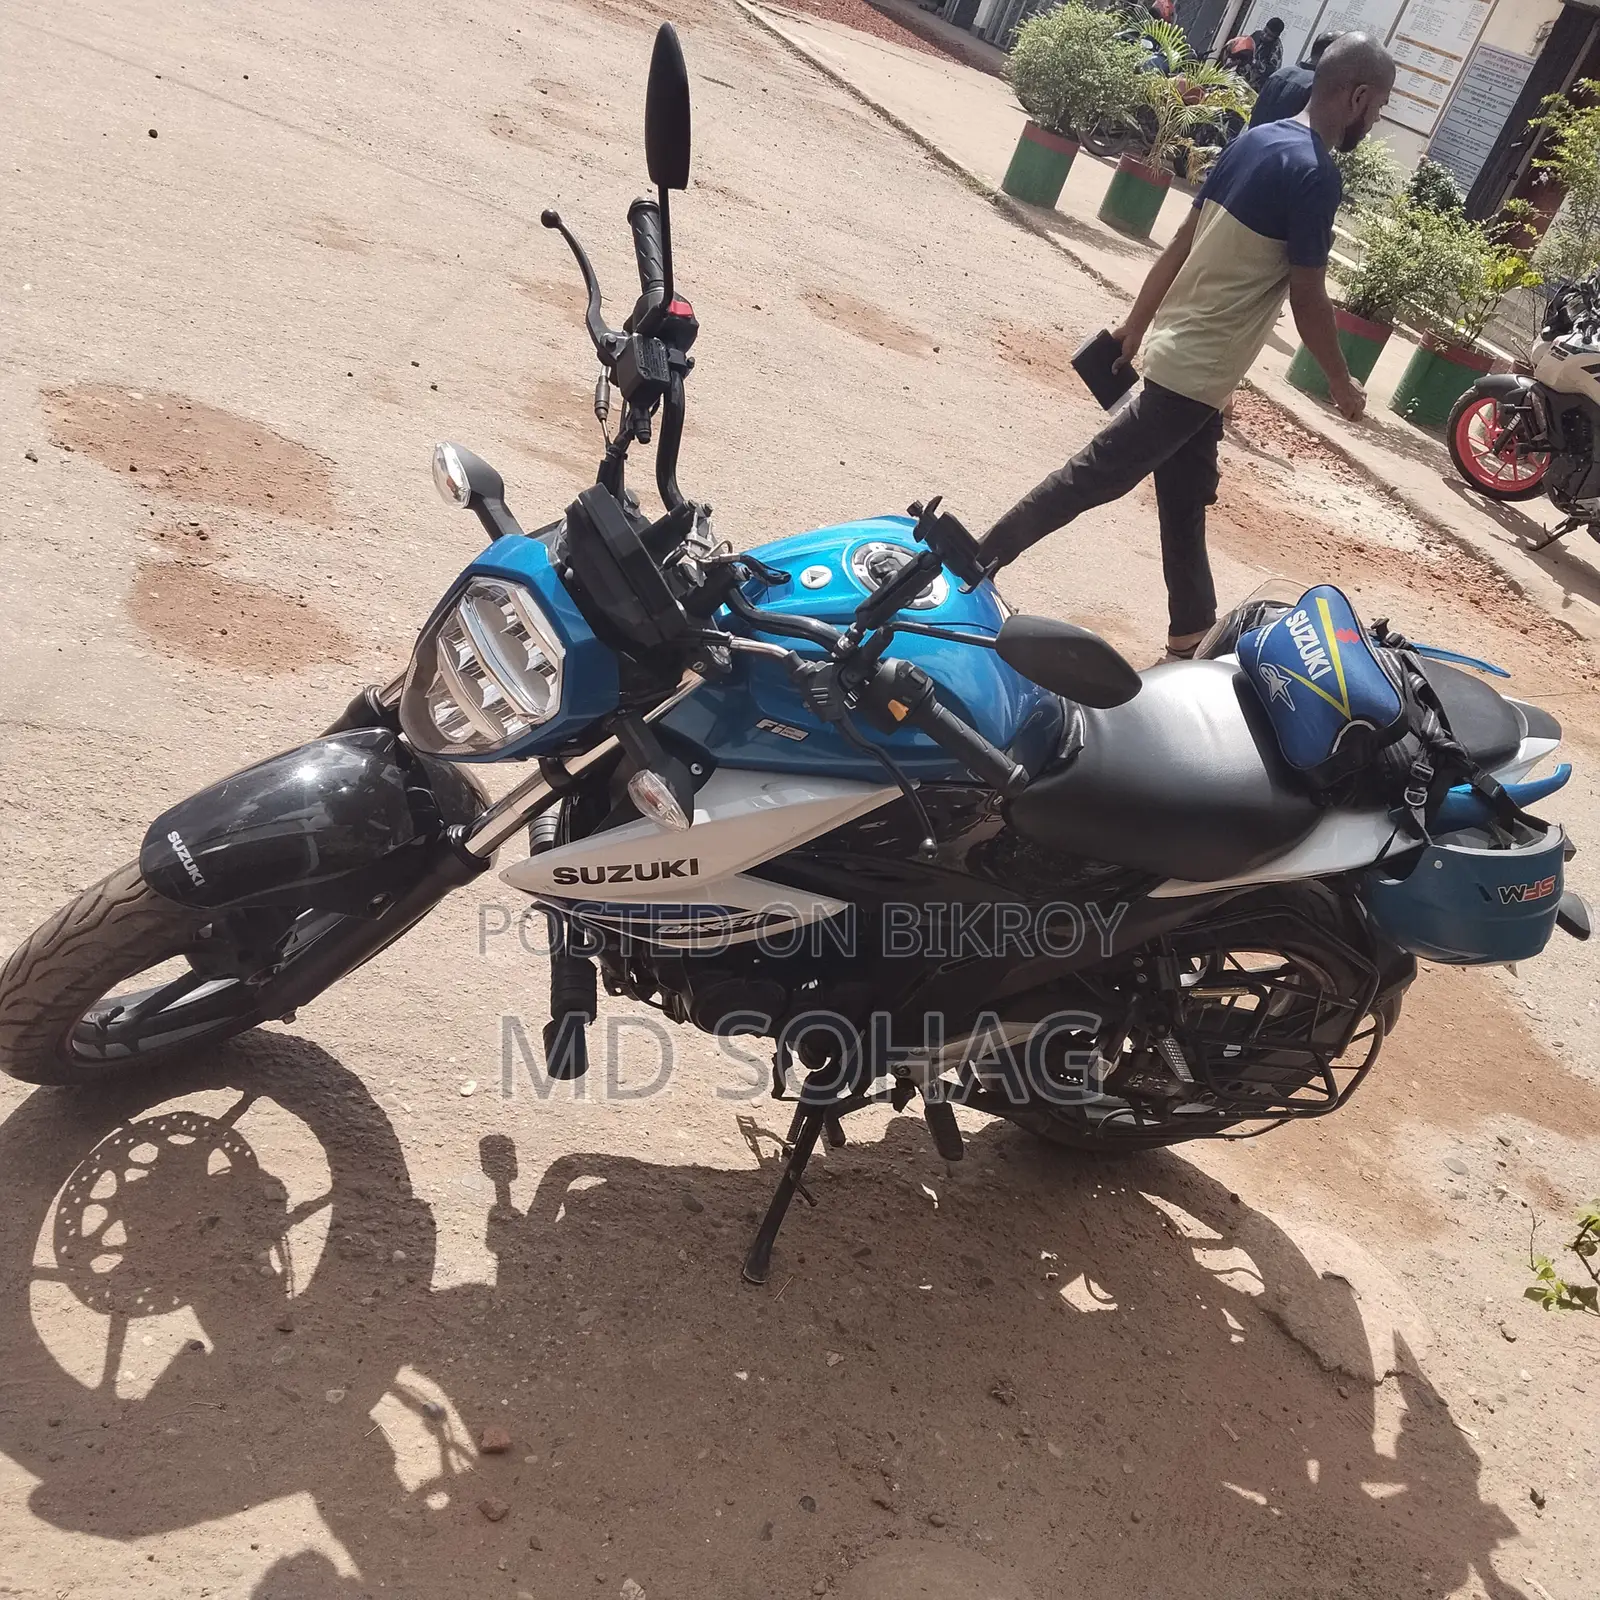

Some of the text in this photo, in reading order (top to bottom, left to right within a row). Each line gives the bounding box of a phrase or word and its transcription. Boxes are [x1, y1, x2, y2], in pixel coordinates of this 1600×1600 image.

[1285, 609, 1333, 681] SUZUKI
[167, 830, 206, 887] SUZUKI
[552, 857, 699, 885] SUZUKI
[1497, 875, 1556, 904] SFM
